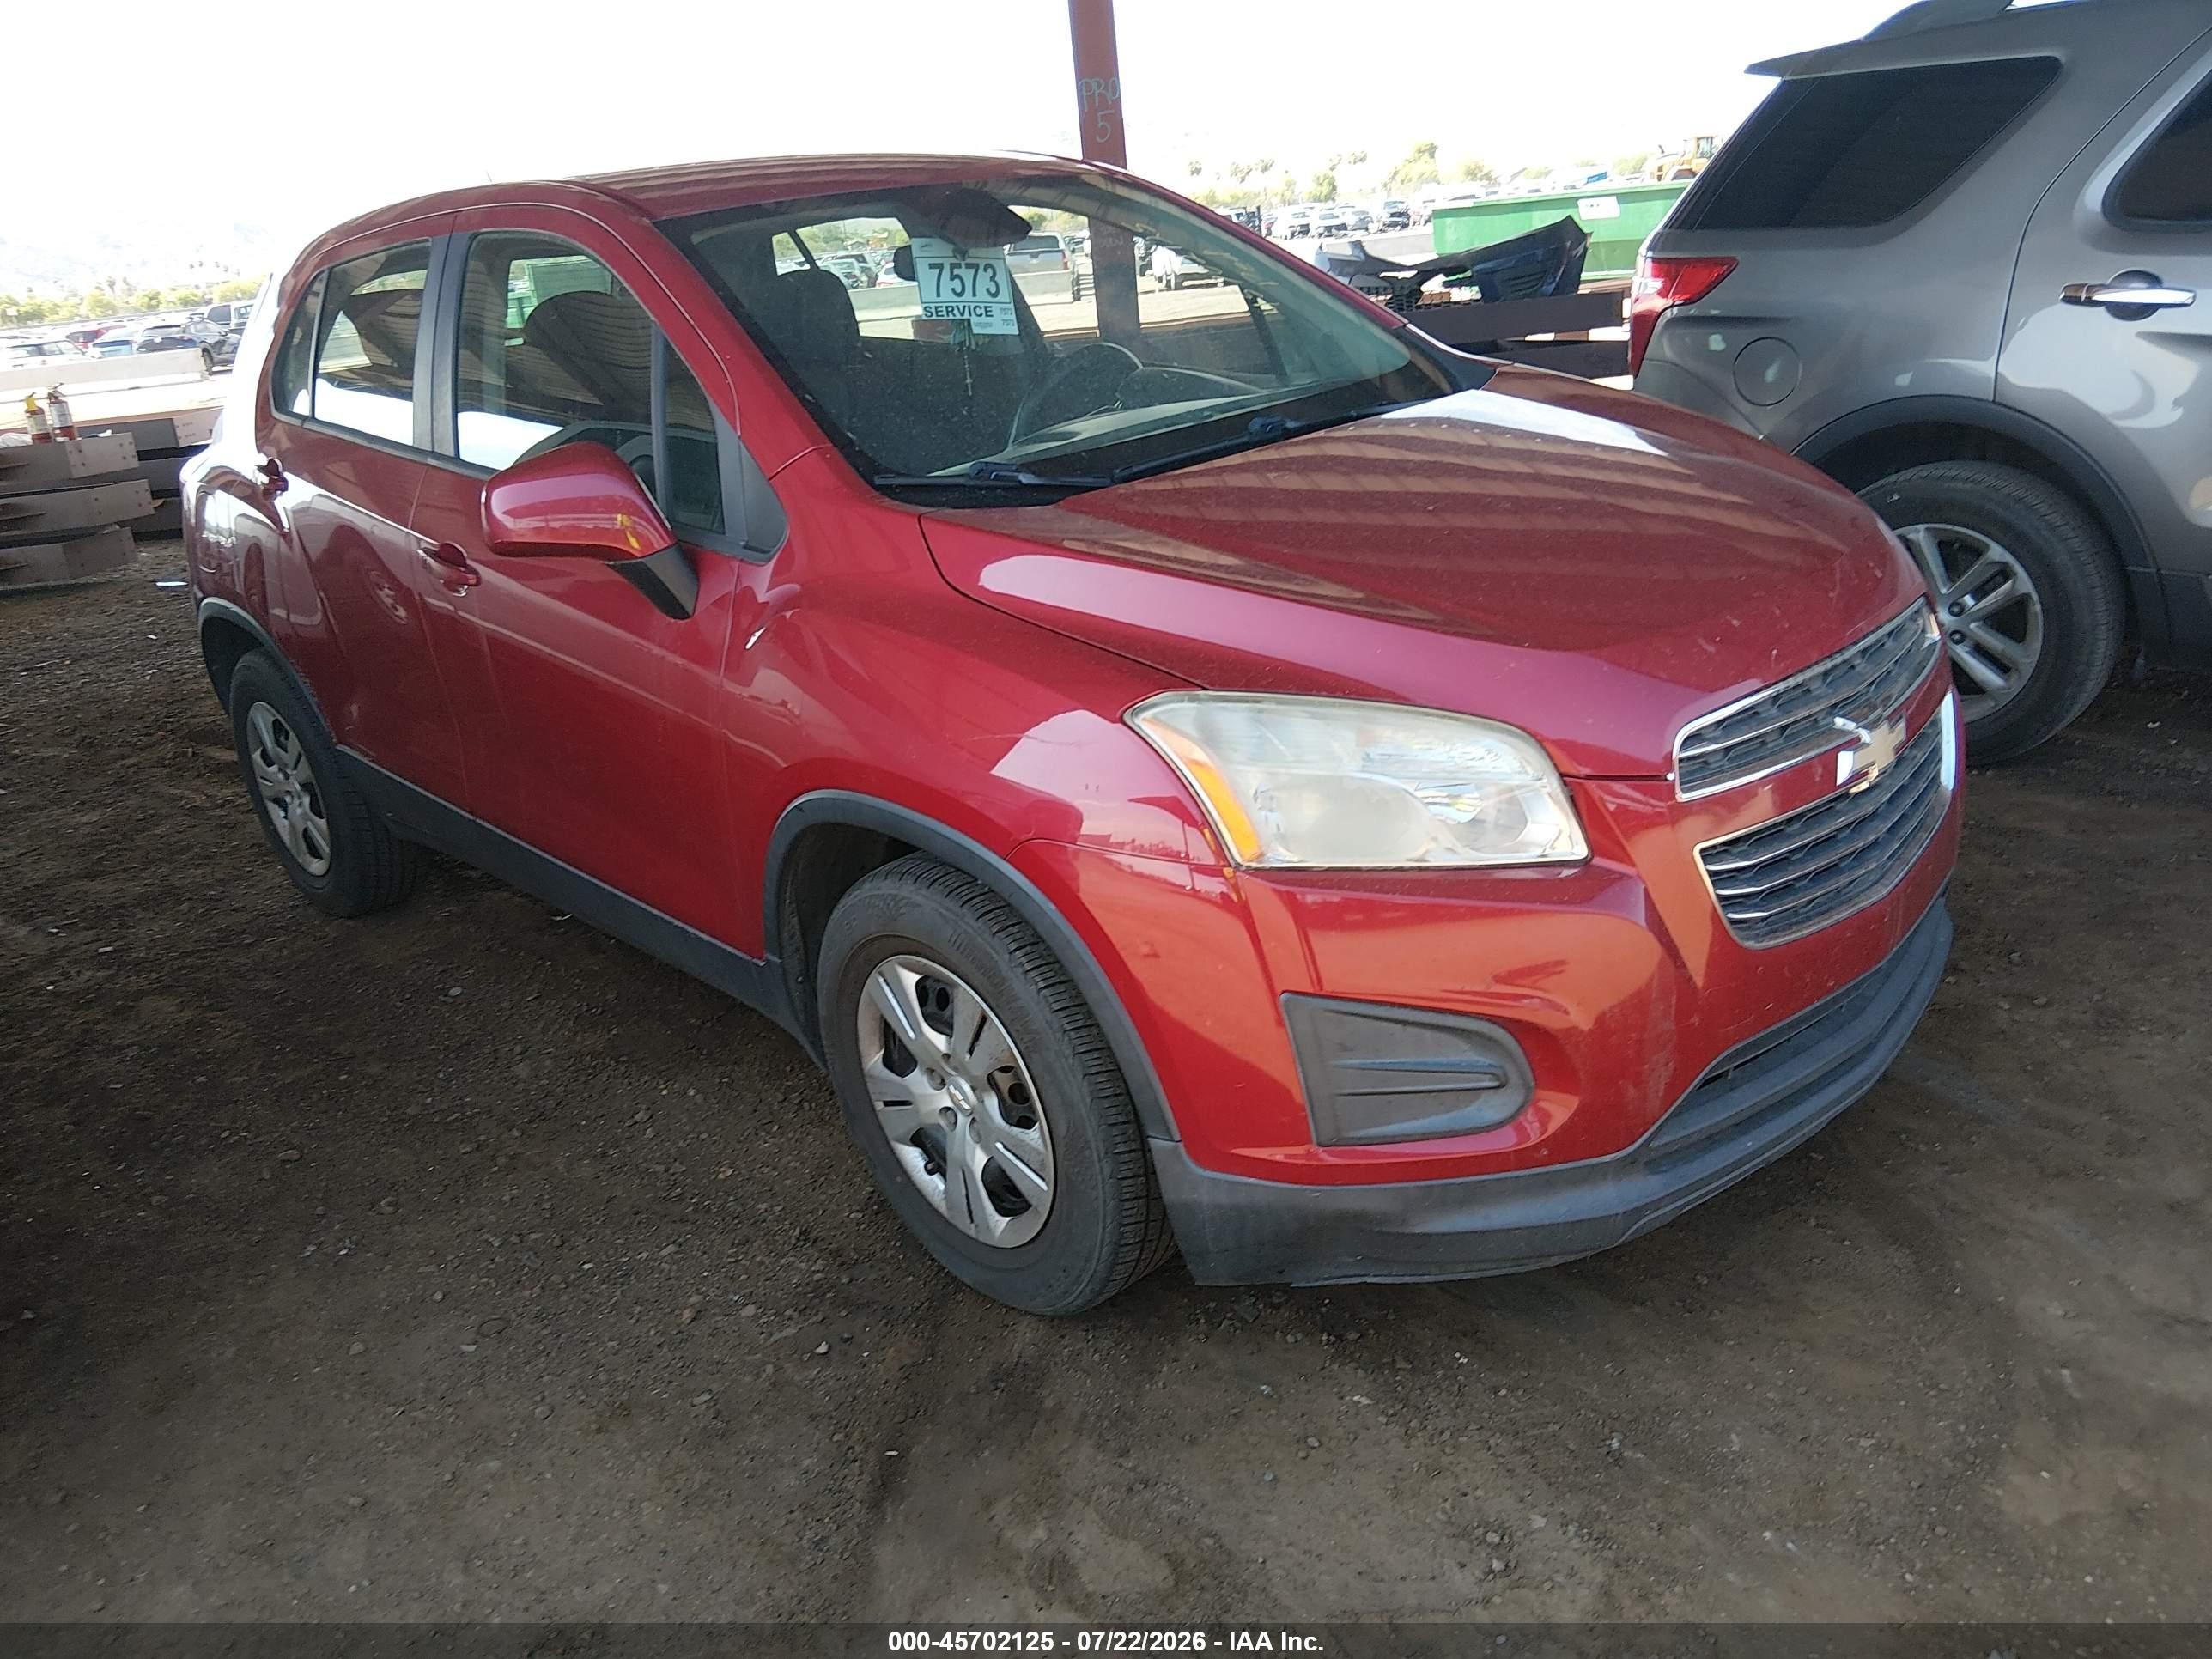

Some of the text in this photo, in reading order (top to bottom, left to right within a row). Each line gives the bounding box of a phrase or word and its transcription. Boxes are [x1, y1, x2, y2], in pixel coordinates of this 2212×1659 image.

[1078, 77, 1120, 112] PRO
[1096, 109, 1115, 143] 5
[928, 263, 1000, 298] 7573
[924, 305, 994, 318] SERVICE
